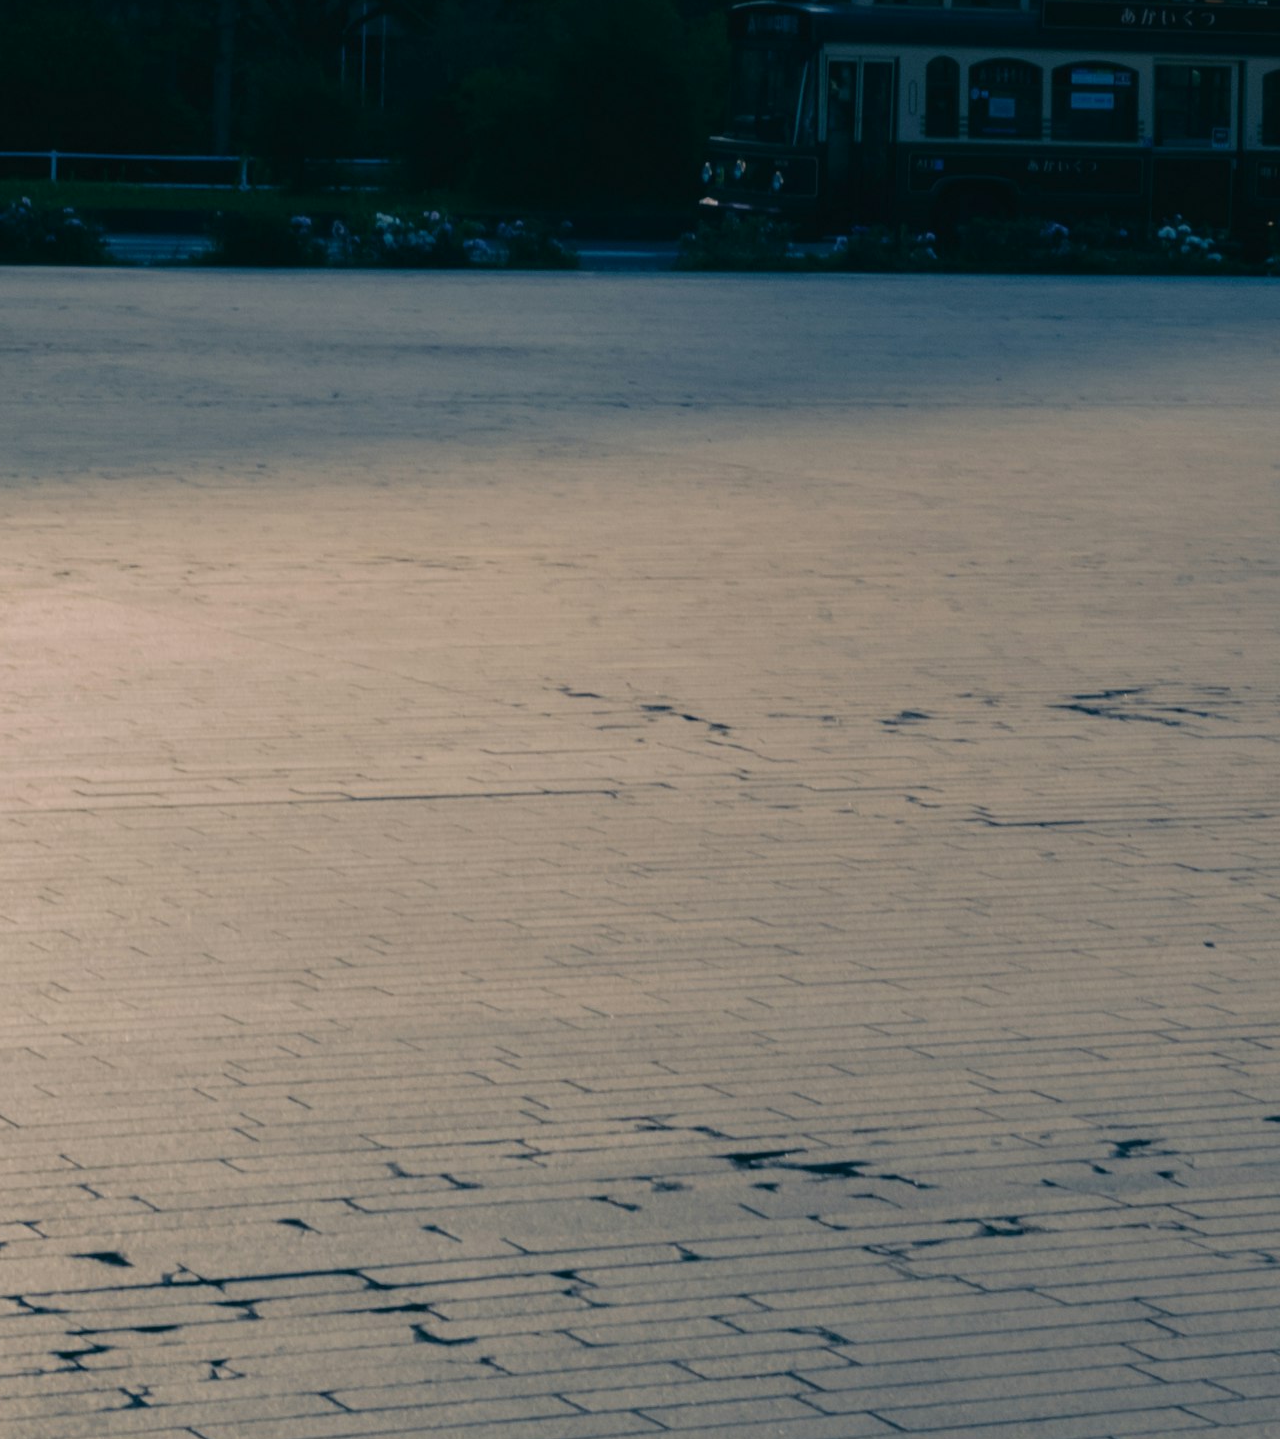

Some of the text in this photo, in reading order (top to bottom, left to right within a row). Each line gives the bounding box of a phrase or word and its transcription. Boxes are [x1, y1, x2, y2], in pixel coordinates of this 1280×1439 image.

[1120, 7, 1217, 27] あかいくつ
